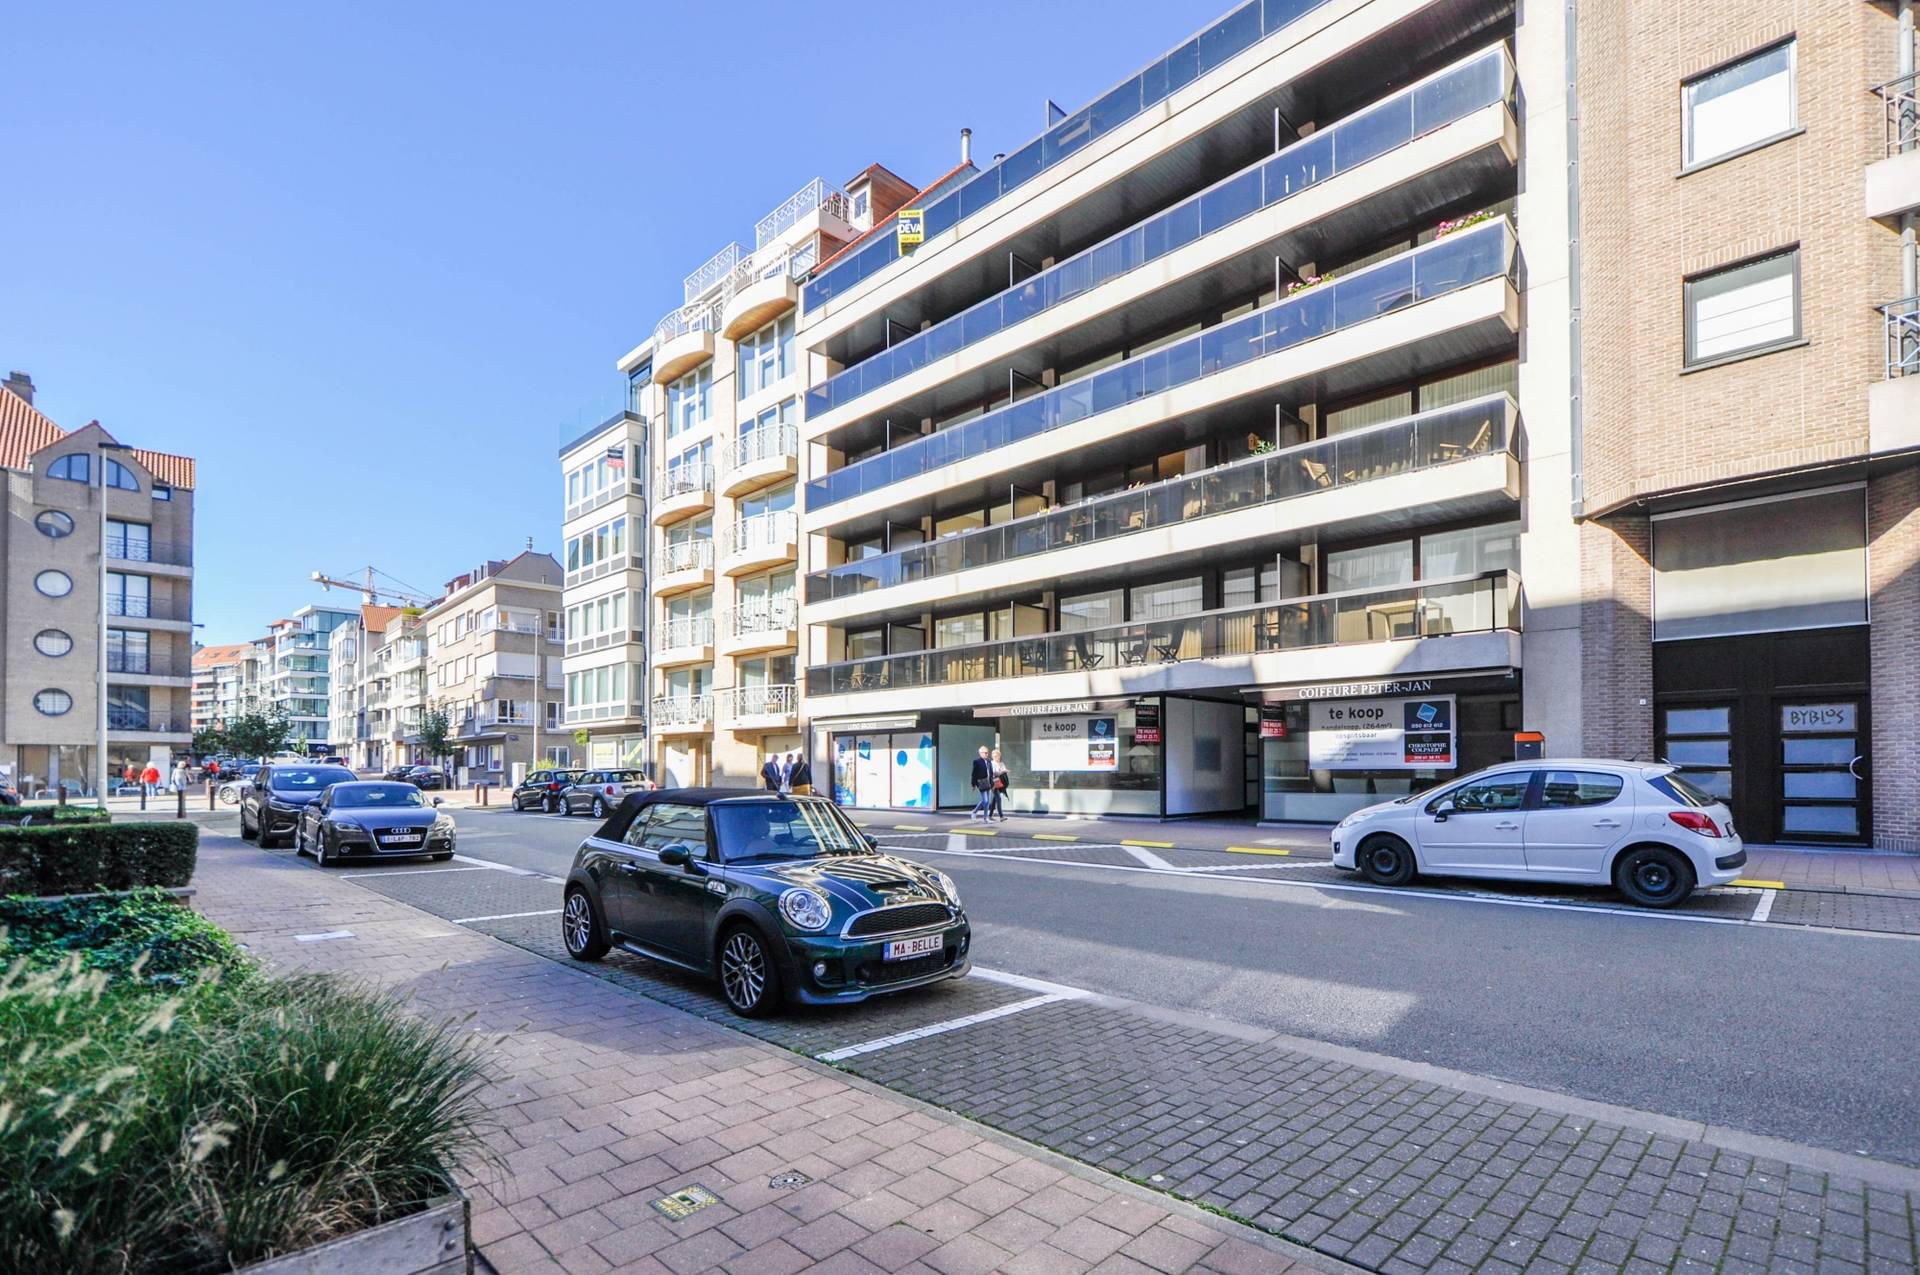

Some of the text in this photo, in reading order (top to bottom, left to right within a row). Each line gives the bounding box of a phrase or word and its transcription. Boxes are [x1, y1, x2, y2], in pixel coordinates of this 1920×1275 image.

[1298, 680, 1432, 699] COIFFURE PETER-JAN
[1010, 702, 1089, 716] COIFFURE PETER-JAN
[1328, 706, 1384, 720] te koop
[1790, 708, 1845, 726] BYBLOS
[1043, 721, 1077, 733] te koop
